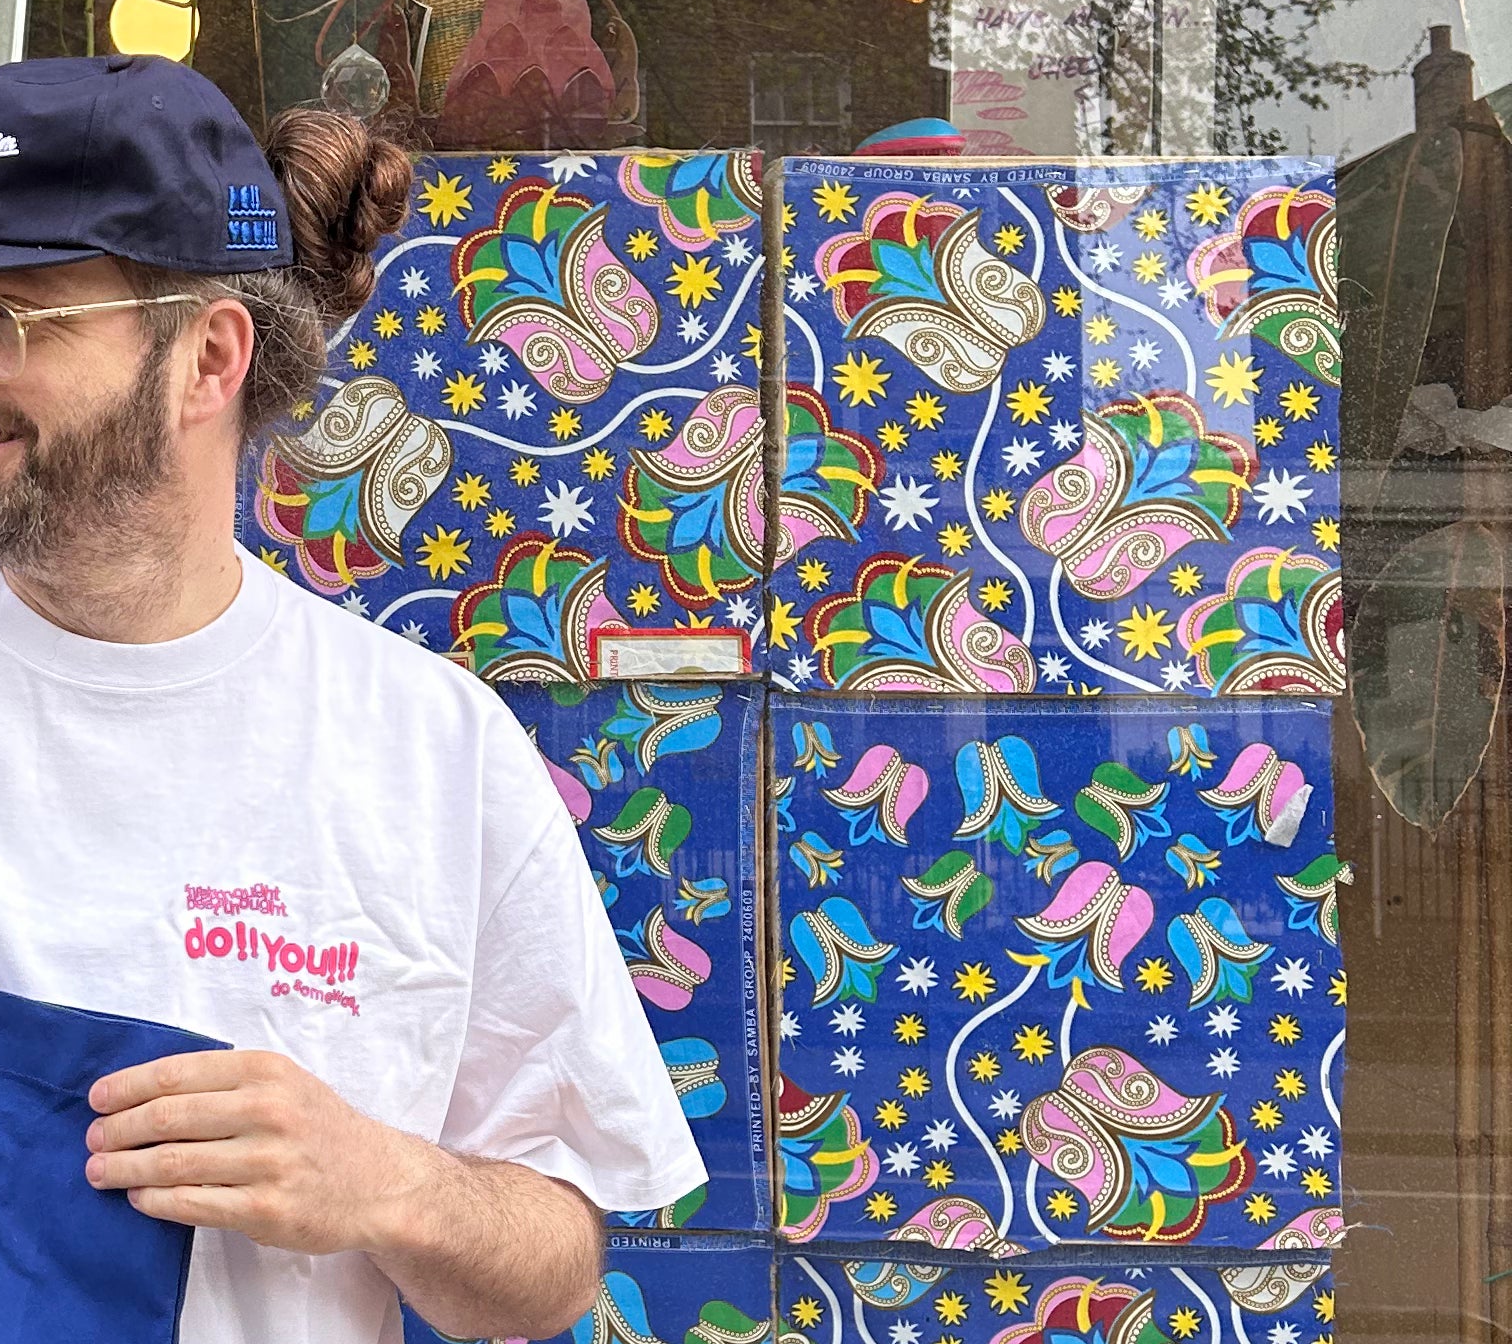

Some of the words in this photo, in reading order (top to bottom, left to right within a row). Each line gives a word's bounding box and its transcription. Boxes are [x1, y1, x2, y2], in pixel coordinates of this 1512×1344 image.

[863, 167, 914, 180] GROUP
[922, 171, 971, 183] SAMBA
[980, 171, 999, 183] BY
[745, 1008, 759, 1057] SAMBA
[748, 1091, 764, 1153] PRINTED
[611, 1236, 671, 1249] PRINTED
